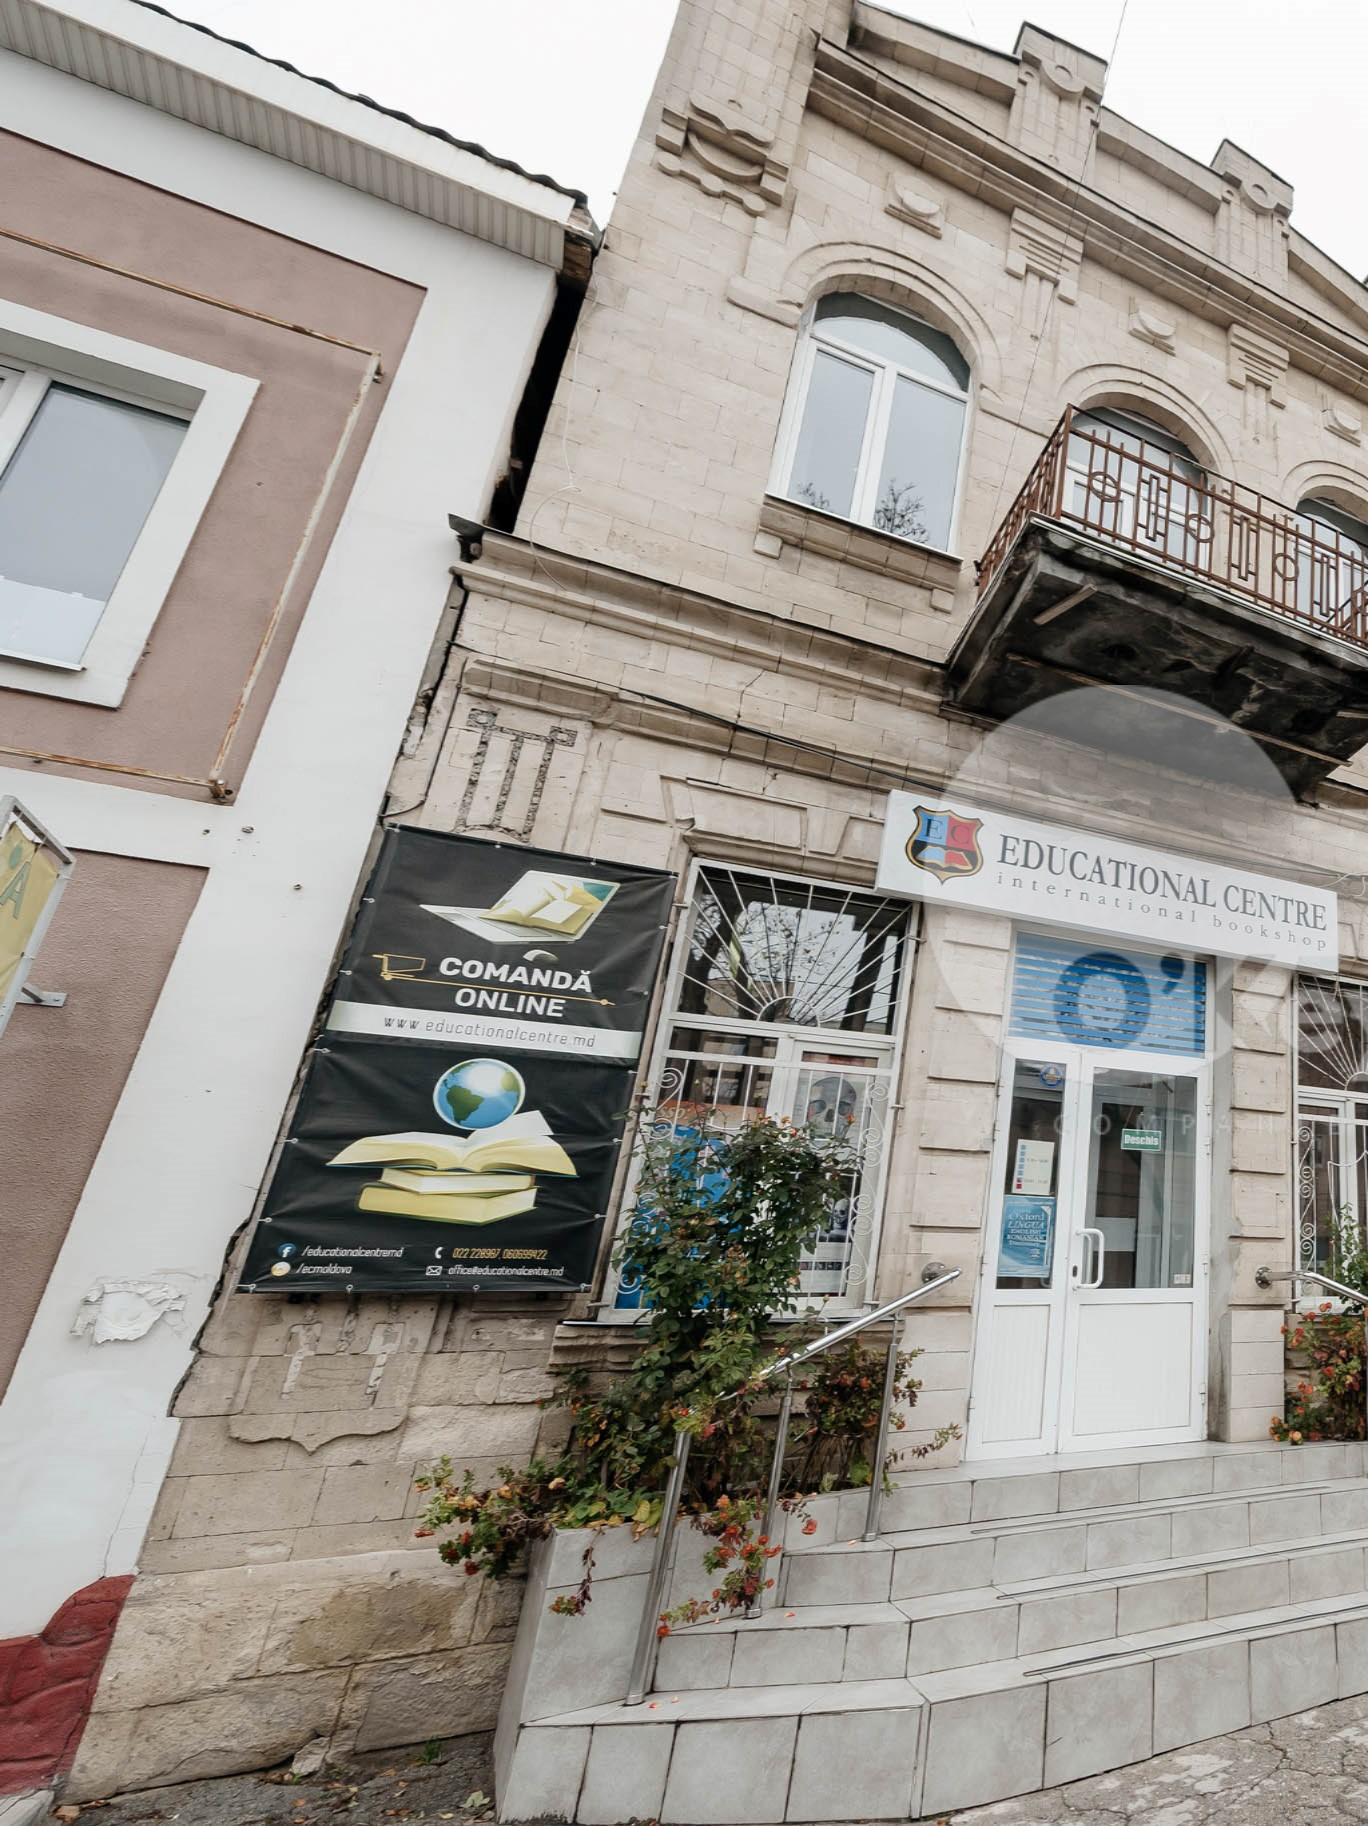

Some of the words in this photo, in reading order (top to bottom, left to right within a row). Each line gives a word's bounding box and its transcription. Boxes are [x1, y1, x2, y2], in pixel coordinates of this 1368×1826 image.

[997, 834, 1217, 908] EDUCATIONAL
[1223, 884, 1327, 932] CENTRE
[997, 872, 1197, 923] international
[1213, 914, 1326, 951] bookshop
[440, 957, 592, 993] COMANDĂ
[455, 988, 567, 1018] ONLINE
[1124, 1134, 1159, 1146] Deschis
[1008, 1220, 1045, 1229] LINGUA
[296, 1263, 352, 1274] /ecmoldova
